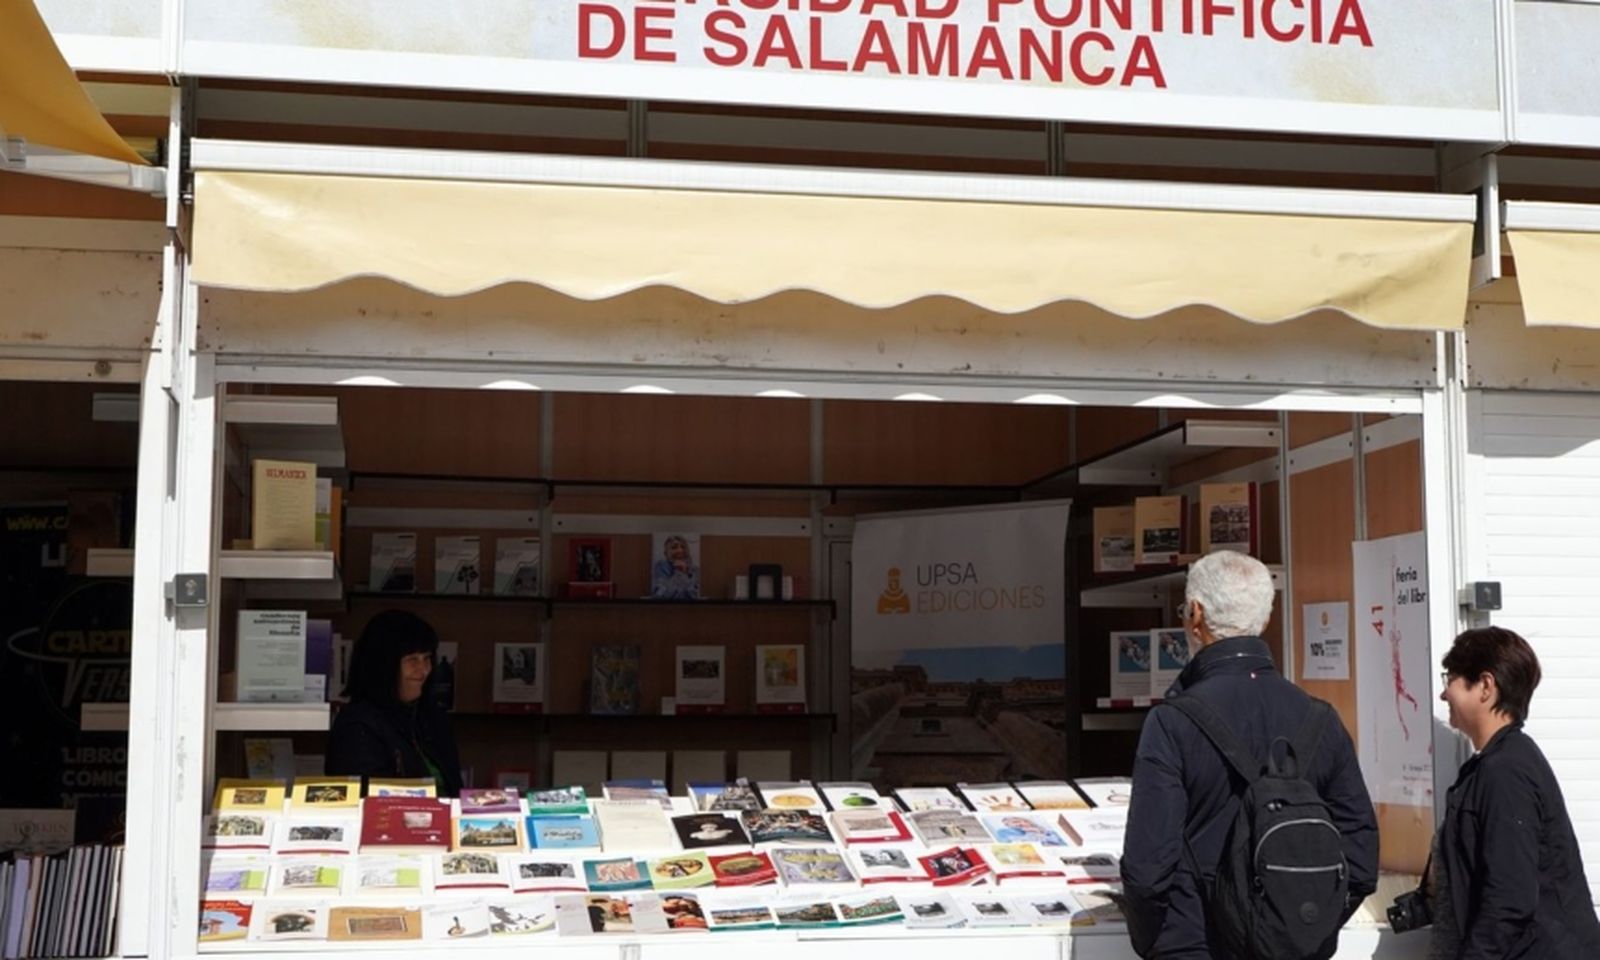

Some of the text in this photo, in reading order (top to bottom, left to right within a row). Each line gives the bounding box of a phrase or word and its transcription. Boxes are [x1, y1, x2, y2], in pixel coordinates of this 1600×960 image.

[578, 3, 1168, 89] DE SALAMANCA
[916, 561, 978, 587] UPSA
[1396, 566, 1418, 582] feria
[917, 584, 1045, 614] EDICIONES
